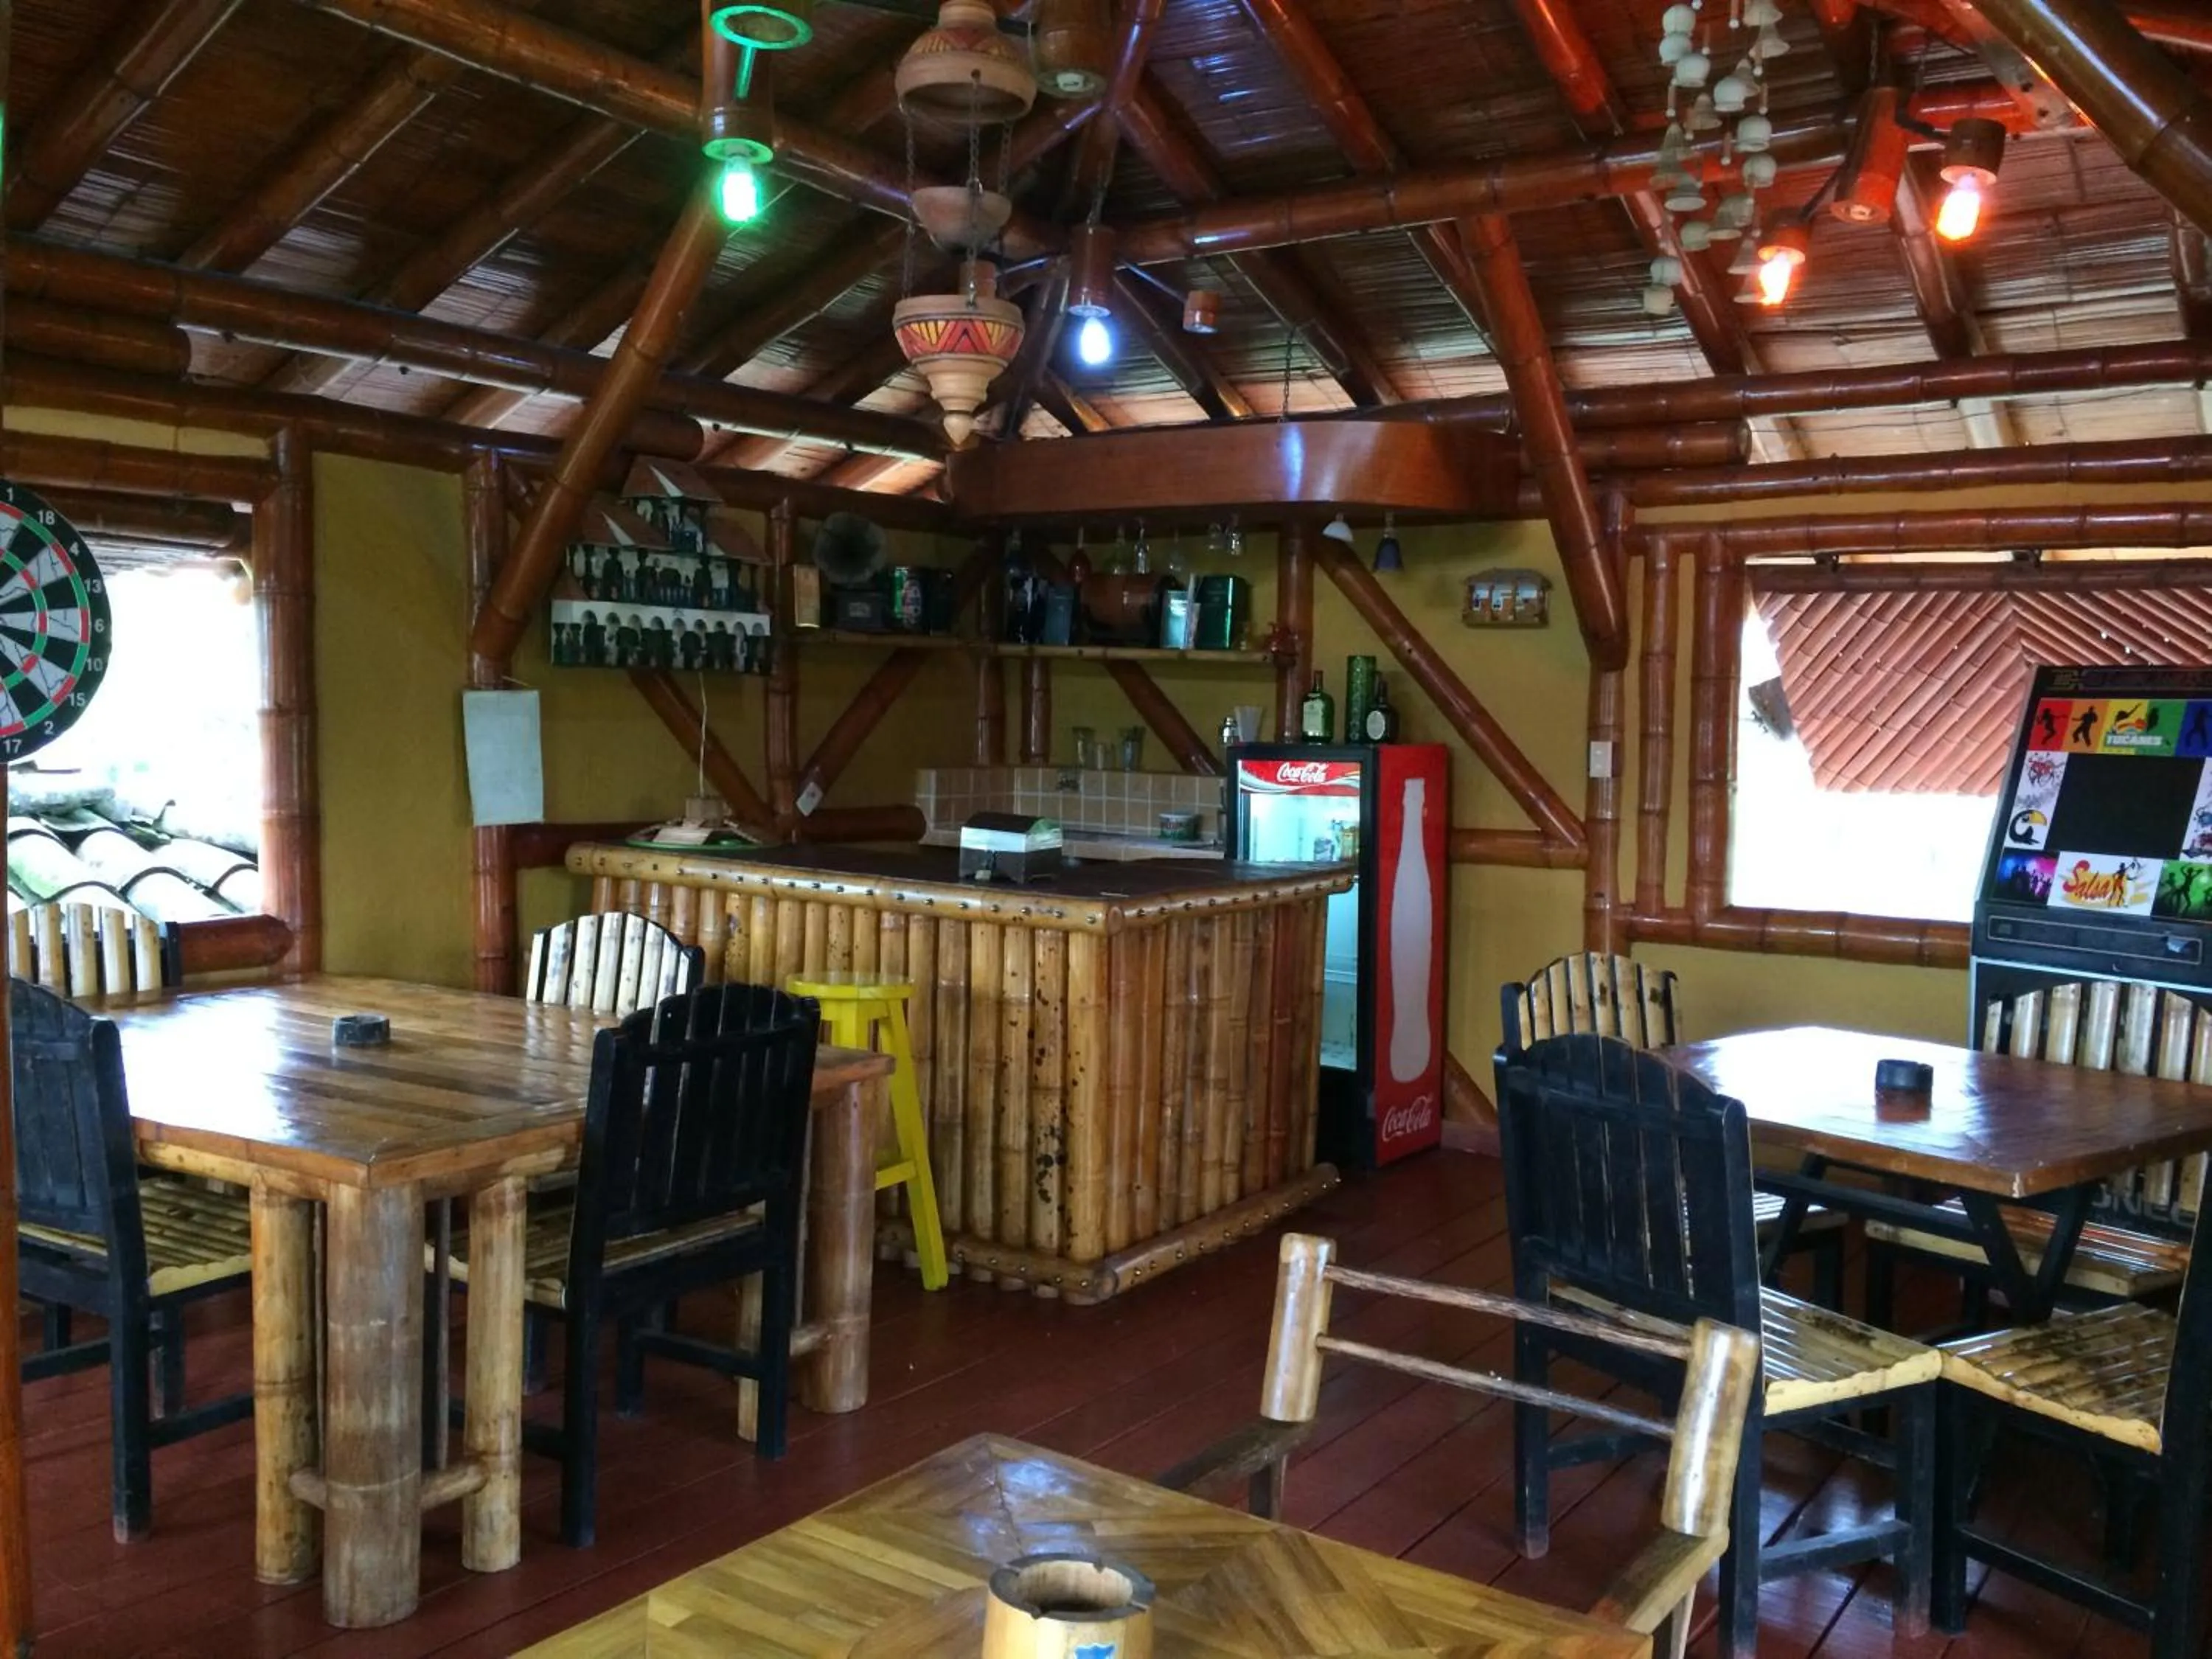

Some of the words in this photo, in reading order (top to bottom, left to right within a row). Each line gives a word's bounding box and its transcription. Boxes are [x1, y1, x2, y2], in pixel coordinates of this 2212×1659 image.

[6, 487, 13, 502] 1
[37, 509, 55, 525] 18
[69, 542, 80, 557] 4
[84, 578, 102, 594] 13
[94, 618, 105, 633] 6
[86, 658, 103, 672] 10
[70, 692, 86, 707] 15
[44, 720, 55, 735] 2
[3, 739, 22, 754] 17
[2062, 860, 2112, 901] Salsa
